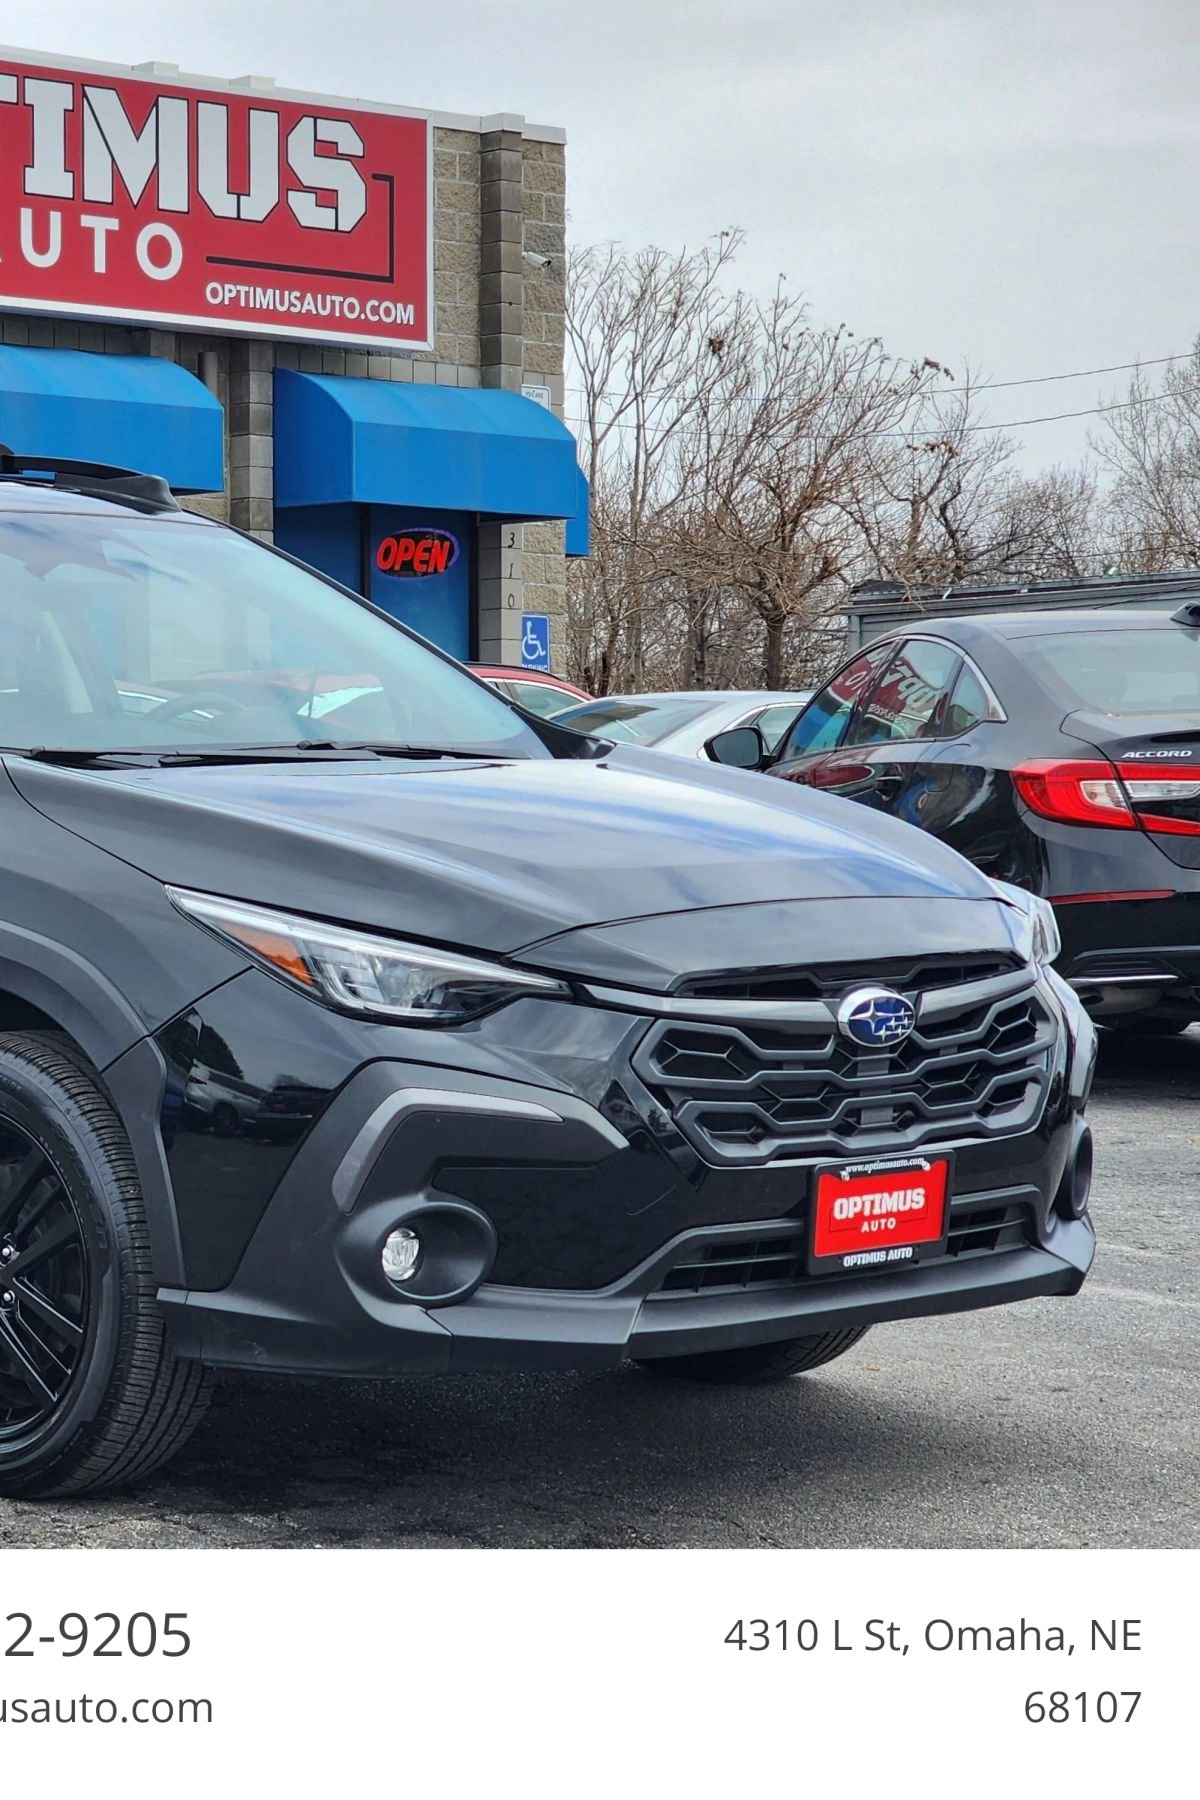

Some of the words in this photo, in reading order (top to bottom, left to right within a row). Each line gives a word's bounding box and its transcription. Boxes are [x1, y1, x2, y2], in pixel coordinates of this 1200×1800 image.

[205, 281, 415, 326] OPTIMUSAUTO.COM
[377, 537, 451, 573] OPEN
[1120, 750, 1193, 759] ACCORD
[833, 1187, 926, 1220] OPTIMUS
[861, 1217, 896, 1233] AUTO
[843, 1251, 886, 1267] OPTIMUS
[887, 1247, 913, 1261] AUTO
